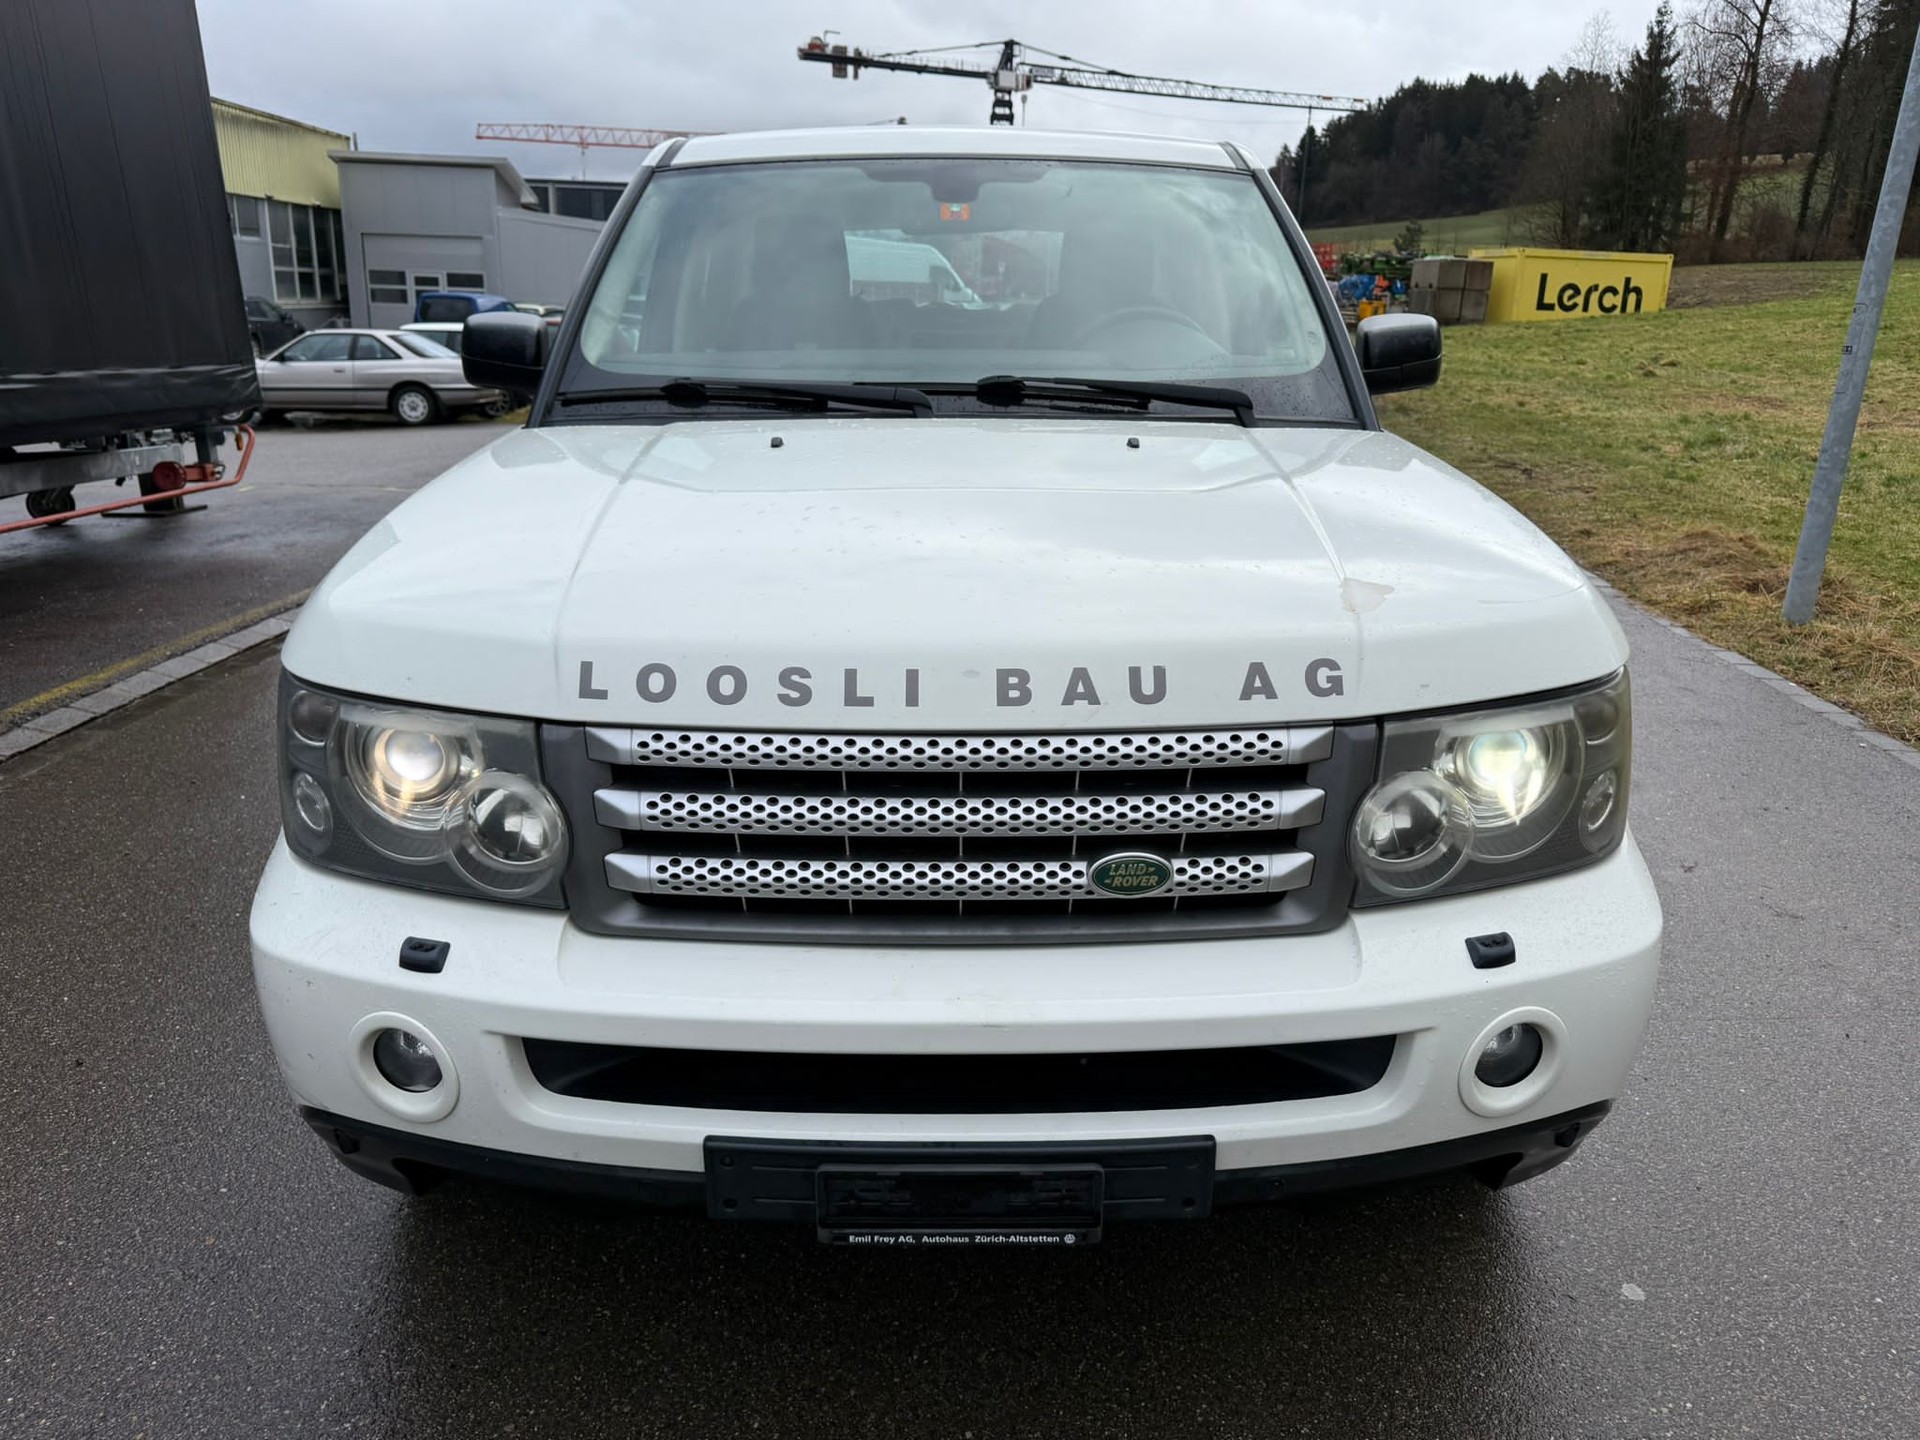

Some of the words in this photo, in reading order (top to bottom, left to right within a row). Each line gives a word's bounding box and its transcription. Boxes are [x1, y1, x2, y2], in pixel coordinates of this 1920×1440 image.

[1535, 272, 1644, 314] Lerch
[578, 660, 920, 707] LOOSLI
[995, 665, 1168, 707] BAU
[1238, 657, 1345, 701] AG
[1109, 863, 1147, 876] LAND
[1112, 875, 1159, 887] ROVER
[849, 1235, 871, 1243] Emil
[874, 1235, 896, 1245] Frey
[898, 1235, 916, 1244] AG,
[921, 1235, 970, 1243] Autohaus
[974, 1234, 1060, 1243] Zürich-Altstetten
